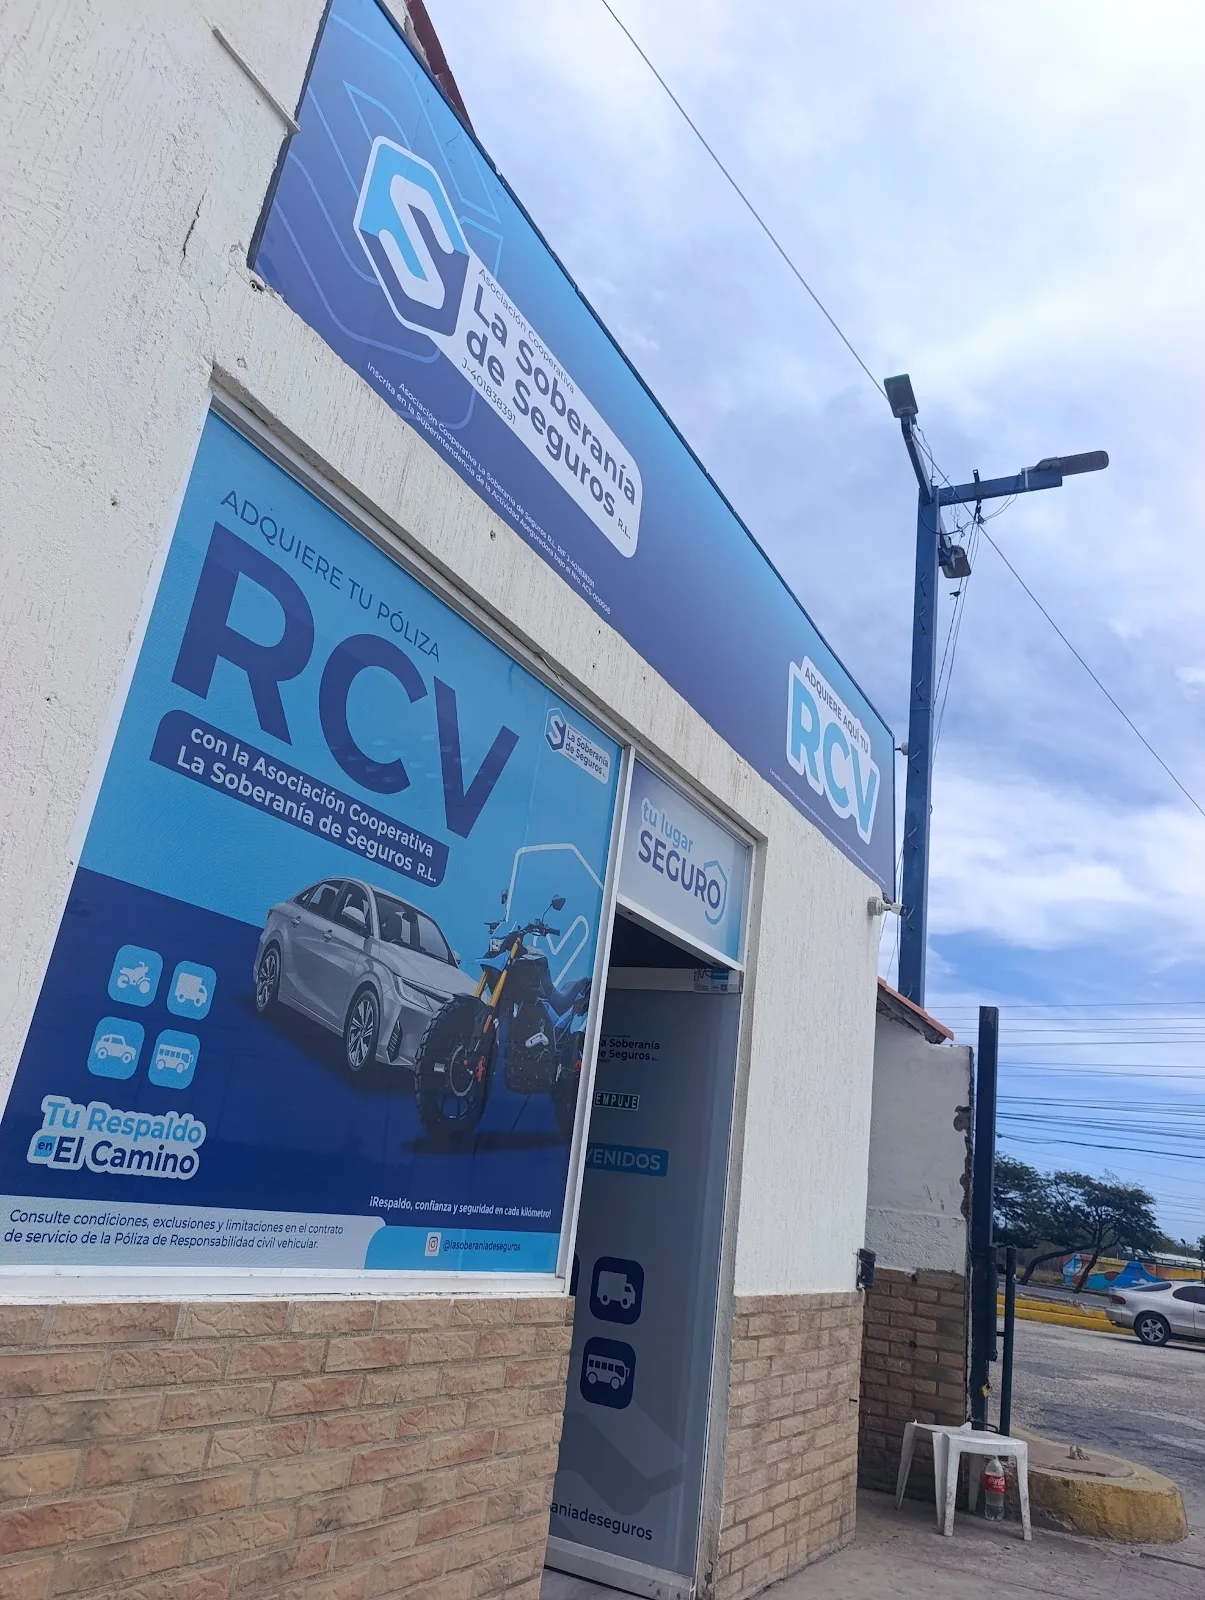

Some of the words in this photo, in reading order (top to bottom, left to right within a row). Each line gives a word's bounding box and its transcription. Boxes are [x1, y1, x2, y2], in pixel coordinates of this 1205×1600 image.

[478, 268, 527, 333] Asociación
[528, 330, 575, 395] Cooperativa
[461, 357, 517, 425] J-401838391
[473, 283, 508, 349] La
[515, 339, 636, 506] Soberanía
[367, 361, 396, 395] Inscrita
[396, 393, 407, 407] en
[407, 403, 415, 415] la
[415, 411, 475, 476] Superintendencia
[475, 473, 485, 486] de
[484, 482, 491, 493] la
[491, 489, 520, 522] Actividad
[519, 518, 554, 557] Aseguradora
[398, 383, 438, 426] Asociación
[438, 423, 477, 467] Cooperativa
[477, 462, 486, 476] La
[486, 472, 516, 507] Soberanía
[516, 504, 525, 515] de
[524, 511, 547, 538] Seguros
[466, 329, 505, 387] de
[511, 378, 615, 518] Seguros
[617, 517, 631, 540] R.L.
[220, 489, 342, 590] ADQUIERE
[348, 577, 373, 610] TU
[377, 599, 441, 664] PÓLIZA
[171, 521, 521, 839] RCV
[804, 666, 843, 722] ADQUIERE
[842, 715, 861, 743] AQUÍ
[860, 735, 870, 755] TU
[565, 742, 575, 754] de
[575, 748, 603, 775] Seguros
[567, 730, 575, 742] La
[576, 737, 609, 768] Soberanía
[790, 673, 878, 832] RCV
[176, 745, 205, 776] La
[210, 761, 314, 827] Soberanía
[318, 812, 343, 841] de
[345, 826, 414, 874] Seguros
[415, 858, 438, 884] R.L.
[190, 727, 230, 757] con
[232, 739, 249, 769] la
[252, 756, 346, 817] Asociación
[348, 804, 435, 859] Cooperativa
[641, 802, 657, 828] tu
[661, 812, 695, 854] lugar
[638, 829, 722, 910] SEGURO
[608, 1049, 651, 1061] Seguros
[609, 1038, 660, 1050] Soberanía
[47, 1101, 80, 1130] Tu
[87, 1107, 203, 1144] Respaldo
[596, 1093, 637, 1108] EMPUJE
[37, 1140, 53, 1153] en
[53, 1136, 85, 1165] El
[91, 1140, 196, 1175] Camino
[4, 1229, 22, 1243] de
[25, 1230, 78, 1245] servicio
[80, 1232, 98, 1245] de
[100, 1232, 112, 1245] la
[114, 1231, 150, 1246] Póliza
[152, 1234, 168, 1246] de
[169, 1234, 255, 1250] Responsabilidad
[256, 1236, 275, 1249] civil
[276, 1238, 319, 1249] vehicular.
[10, 1209, 70, 1225] Consulte
[73, 1211, 149, 1228] condiciones,
[152, 1217, 215, 1231] exclusiones
[216, 1220, 225, 1233] y
[225, 1218, 283, 1233] limitaciones
[285, 1224, 297, 1234] en
[298, 1223, 308, 1234] el
[308, 1225, 344, 1235] contrato
[415, 1200, 452, 1213] confianza
[452, 1204, 459, 1215] y
[459, 1204, 494, 1217] seguridad
[495, 1207, 503, 1215] en
[504, 1206, 520, 1216] cada
[520, 1206, 551, 1218] kilómetro!
